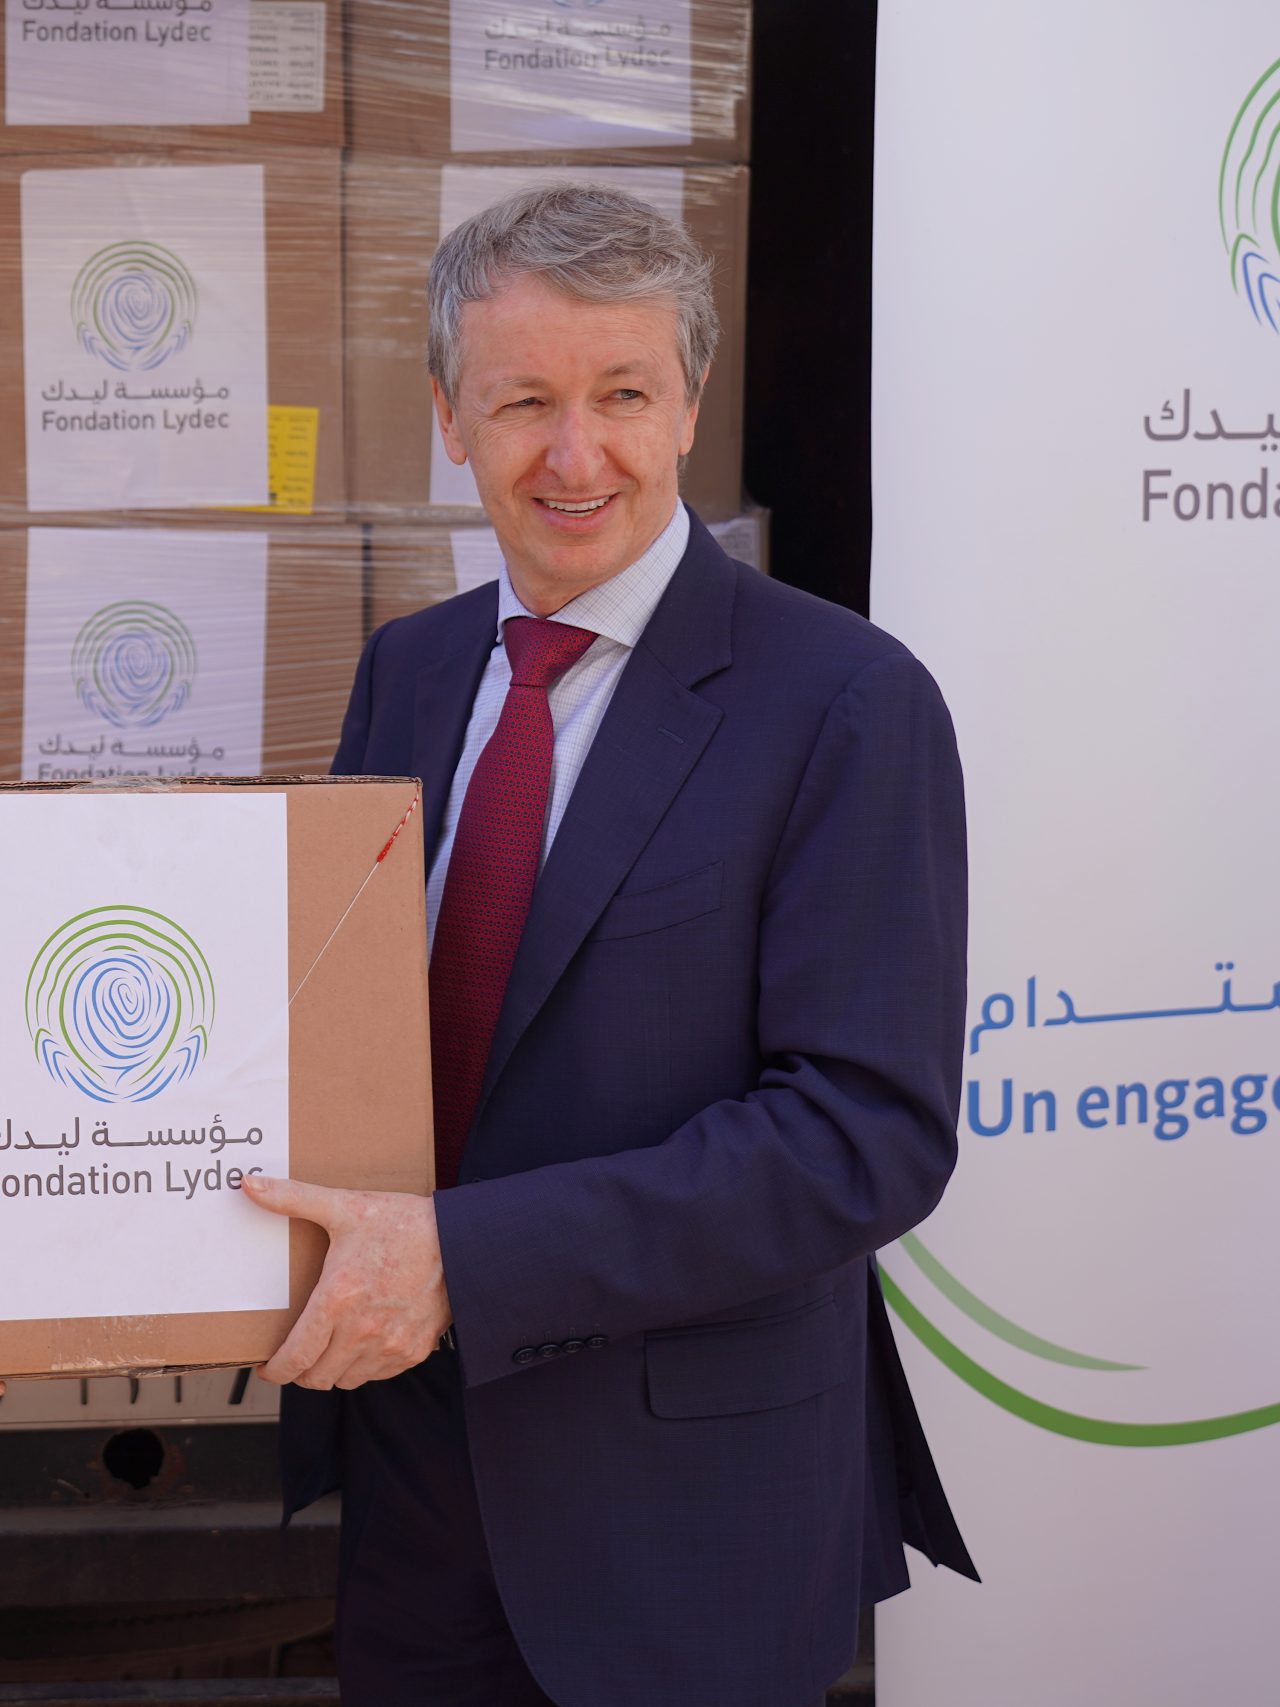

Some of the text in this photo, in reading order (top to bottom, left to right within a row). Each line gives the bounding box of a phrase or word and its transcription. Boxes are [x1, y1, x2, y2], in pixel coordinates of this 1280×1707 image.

[22, 20, 212, 47] Fondation Lydec
[484, 48, 598, 70] Fondation
[41, 379, 229, 405] مؤسسة ليدك
[42, 410, 229, 434] Fondation Lydec
[970, 961, 1280, 1055] تدام
[967, 1074, 1280, 1141] Un engag
[91, 1113, 263, 1153] مؤسسة
